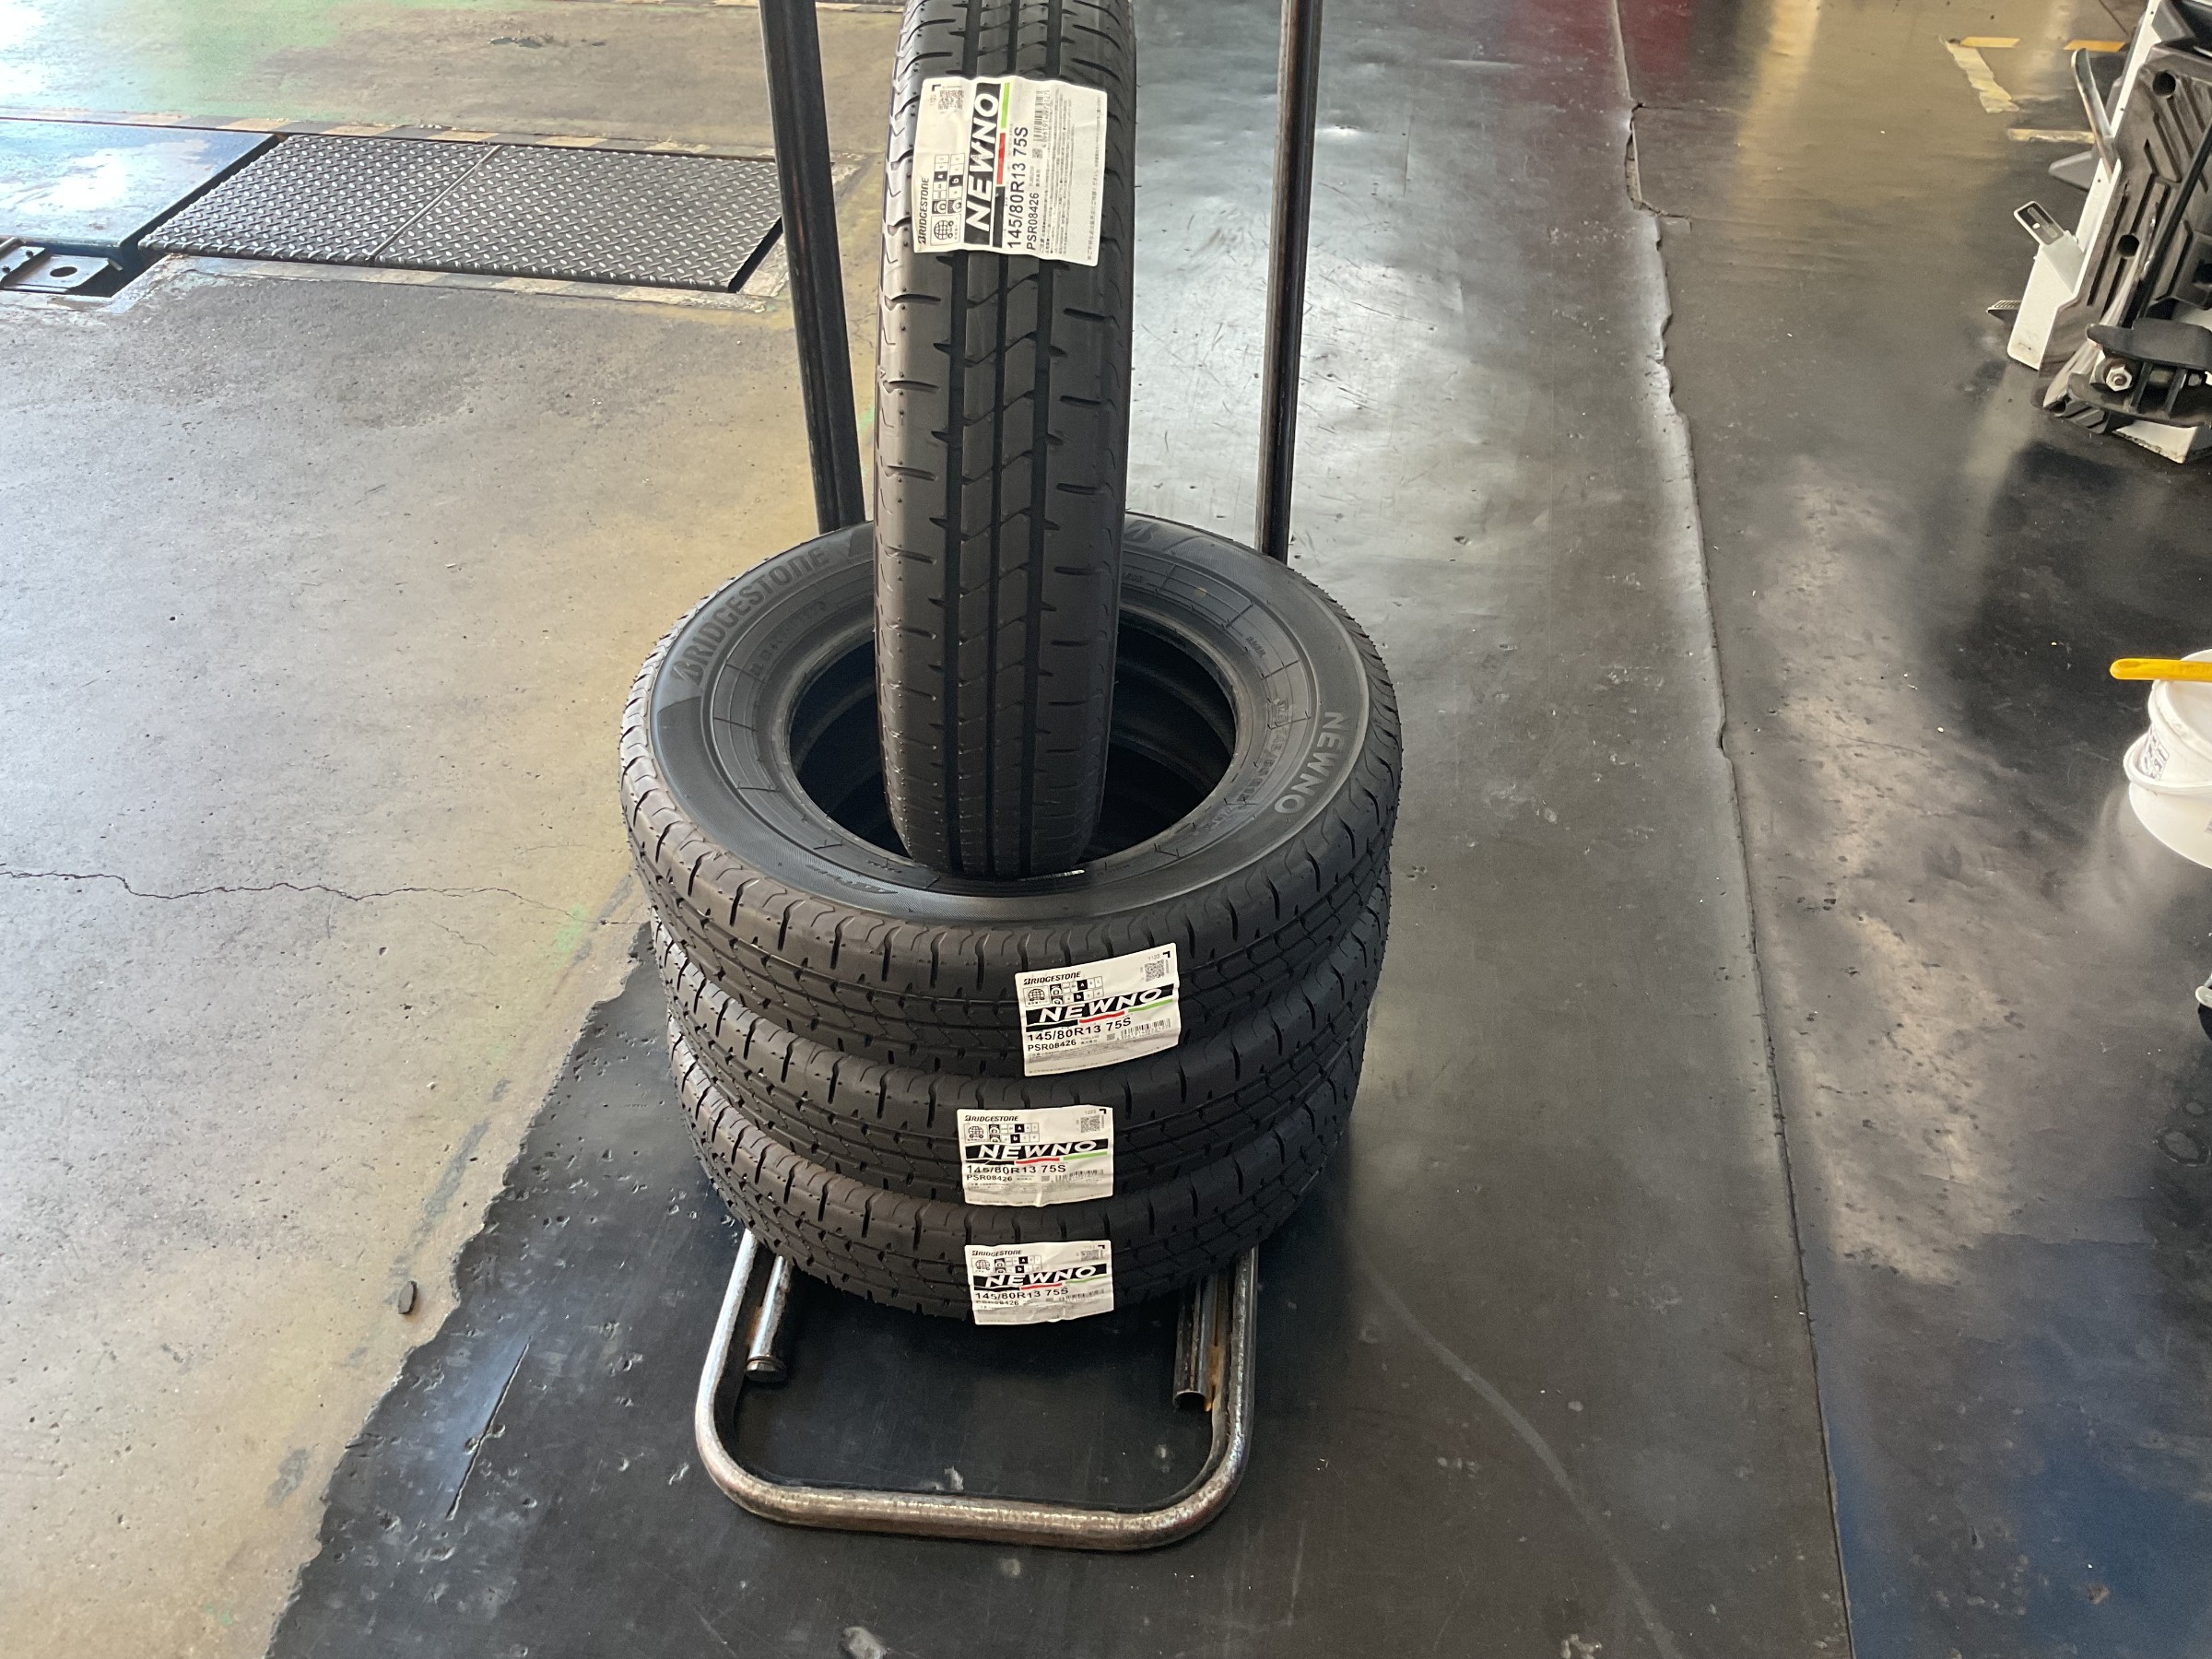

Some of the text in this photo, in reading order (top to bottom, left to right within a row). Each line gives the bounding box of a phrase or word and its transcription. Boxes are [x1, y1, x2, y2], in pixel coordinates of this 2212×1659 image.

[965, 92, 1000, 232] NEWNO
[1007, 126, 1030, 250] 145/80R13 75S
[918, 177, 930, 245] BRIDGESTONE
[1026, 192, 1040, 251] PSR08426
[670, 546, 830, 687] BRIDGESTONE
[1274, 712, 1345, 814] NEWNO
[1023, 971, 1082, 985] BRIDGESTONE
[1039, 988, 1162, 1023] NEWNO
[1027, 1025, 1101, 1042] 145/80R13
[1106, 1017, 1132, 1032] 75S
[1028, 1038, 1077, 1052] PSR08426
[978, 1140, 1097, 1159] NEWNO
[966, 1164, 1066, 1174] 145/80R13 75S
[971, 1249, 1023, 1257] BRIDGESTONE
[984, 1265, 1097, 1288] NEWNO
[975, 1287, 1069, 1300] 145/80R13 75S
